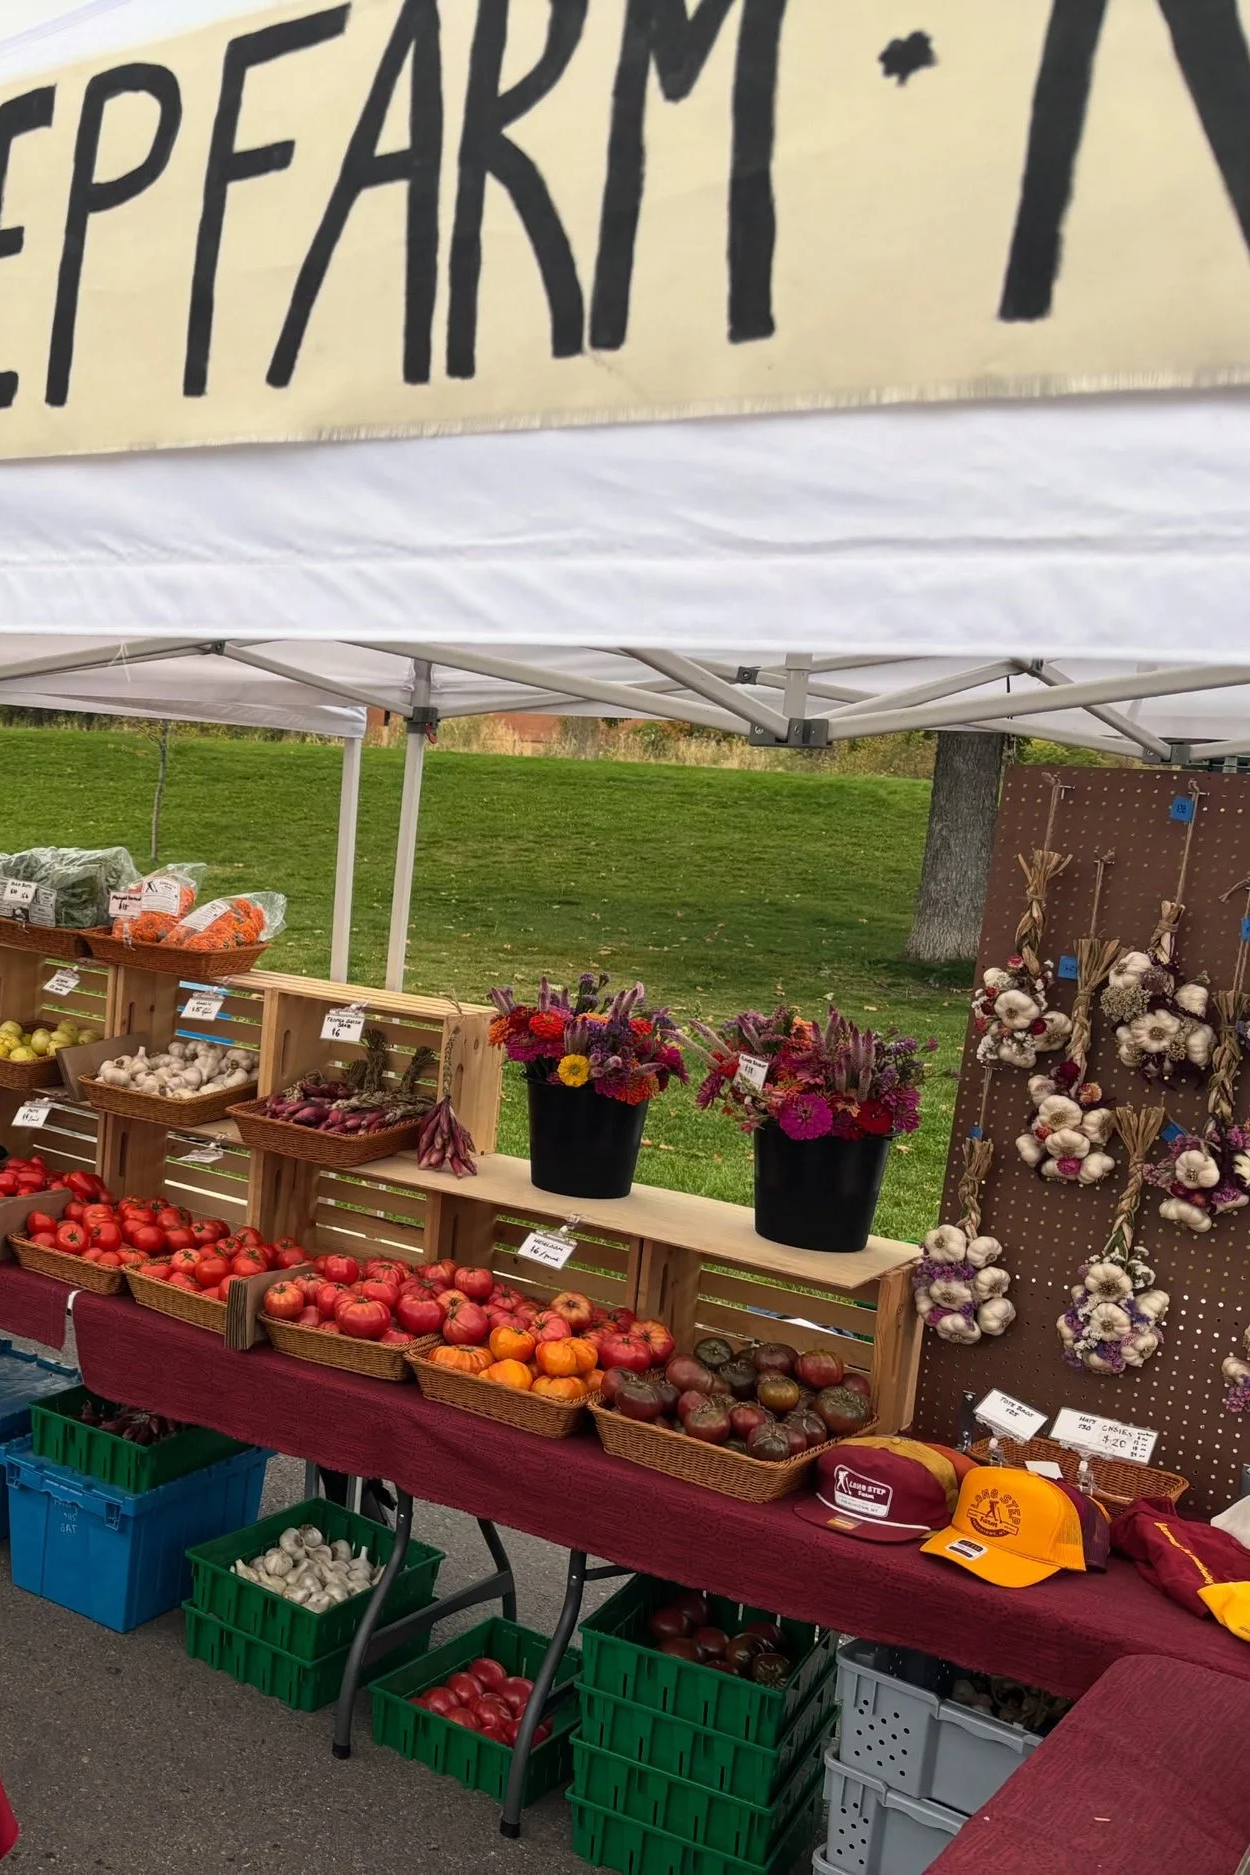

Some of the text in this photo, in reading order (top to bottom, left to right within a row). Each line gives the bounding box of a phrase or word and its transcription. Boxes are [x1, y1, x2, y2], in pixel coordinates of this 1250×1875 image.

[533, 1238, 564, 1252] HEIRLOOM
[1000, 1396, 1035, 1418] TOTE BAGS
[1078, 1415, 1097, 1425] HATS
[849, 1480, 886, 1496] LONG STEP
[970, 1488, 1021, 1526] LONG STEP
